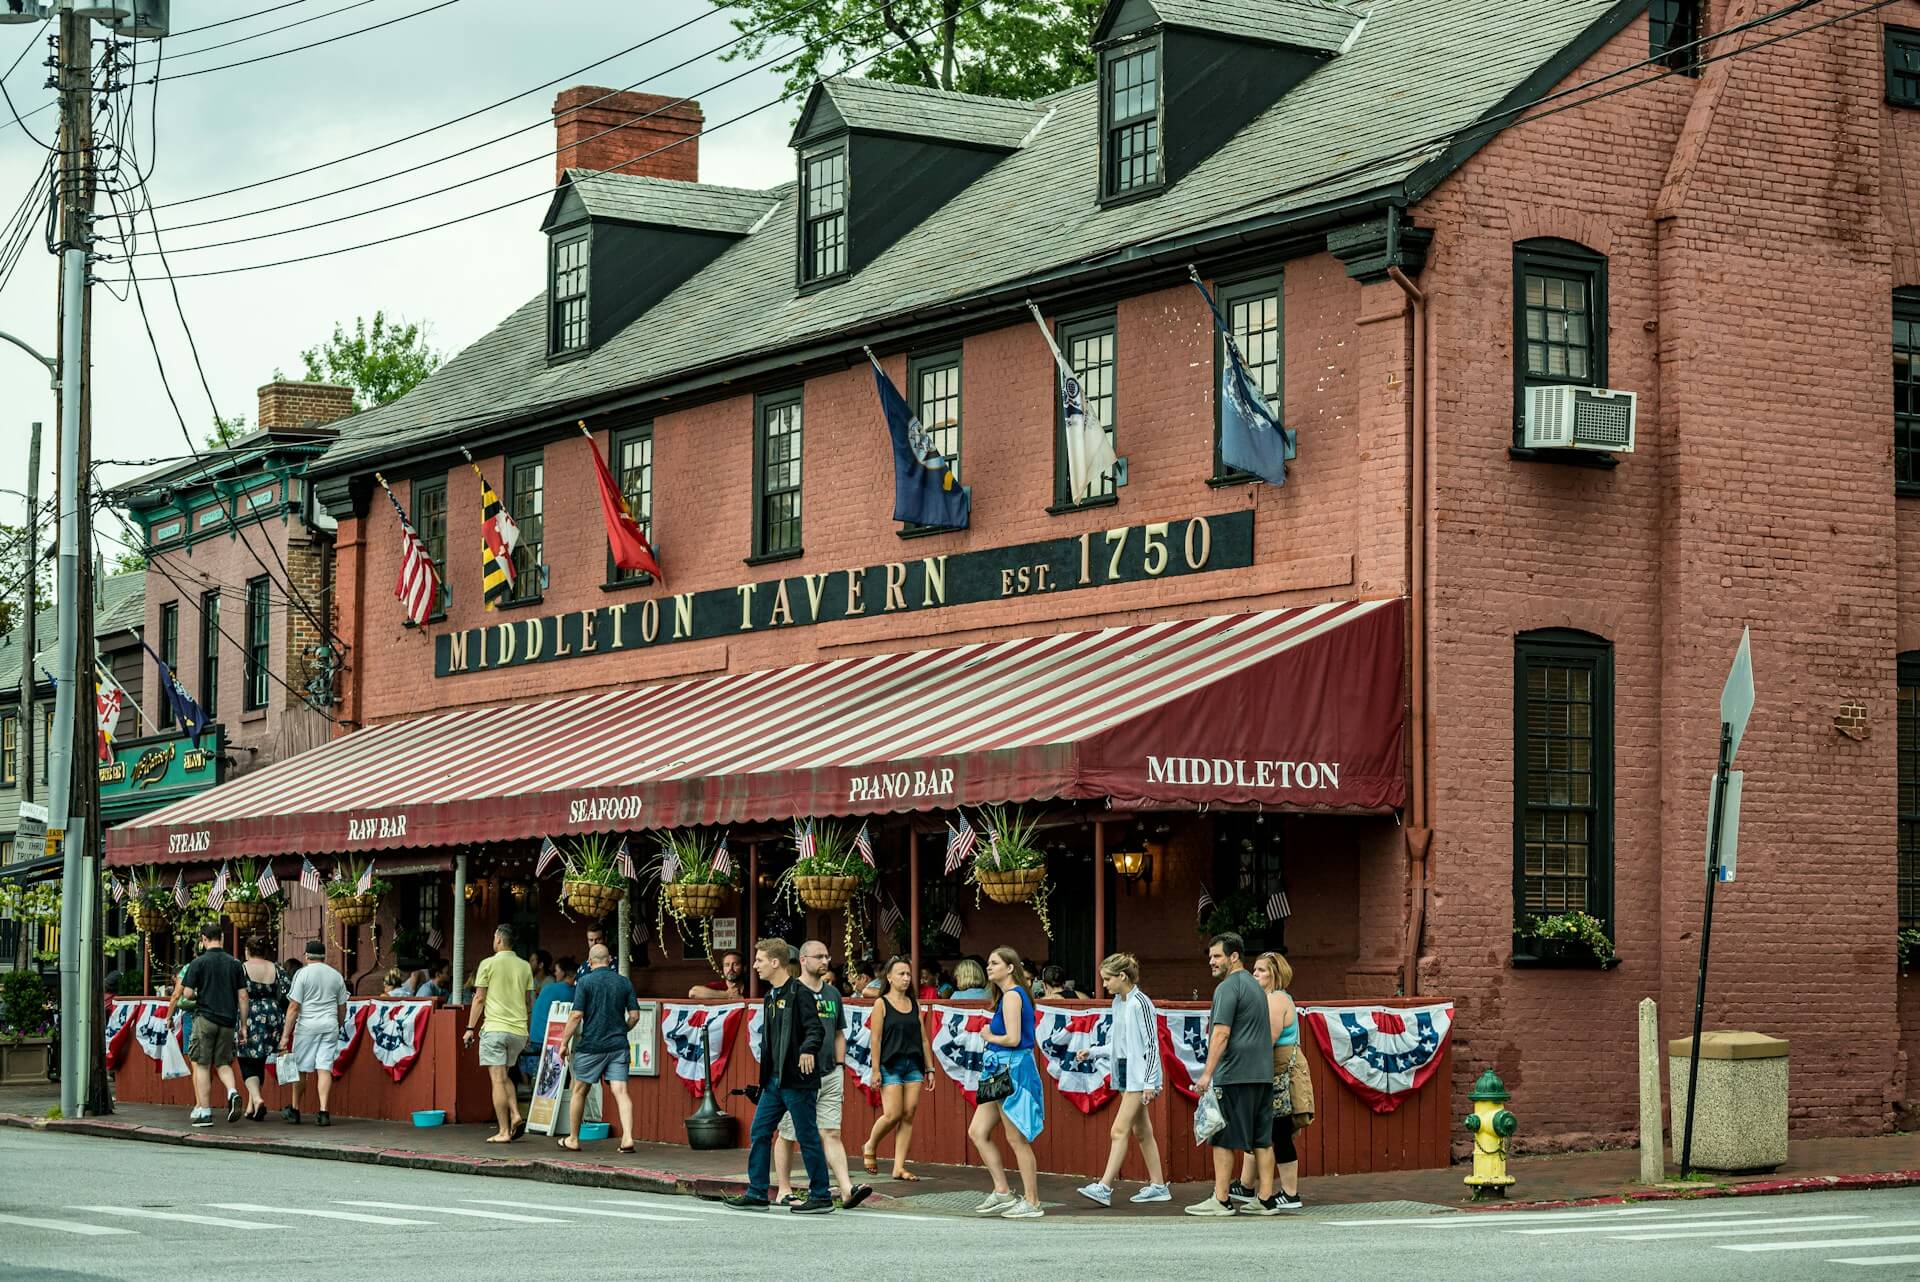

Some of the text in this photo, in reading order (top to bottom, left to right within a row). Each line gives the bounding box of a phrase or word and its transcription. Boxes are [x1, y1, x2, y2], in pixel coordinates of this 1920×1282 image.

[448, 516, 1212, 672] MIDDLETON TAVERN EST. 1750
[847, 768, 954, 802] PIANO BAR
[1145, 755, 1340, 790] MIDDLETON
[568, 795, 643, 824] SEAFOOD
[347, 814, 407, 841] RAW BAR
[15, 840, 25, 850] NO
[28, 841, 45, 852] THRU
[168, 831, 211, 854] STEAKS
